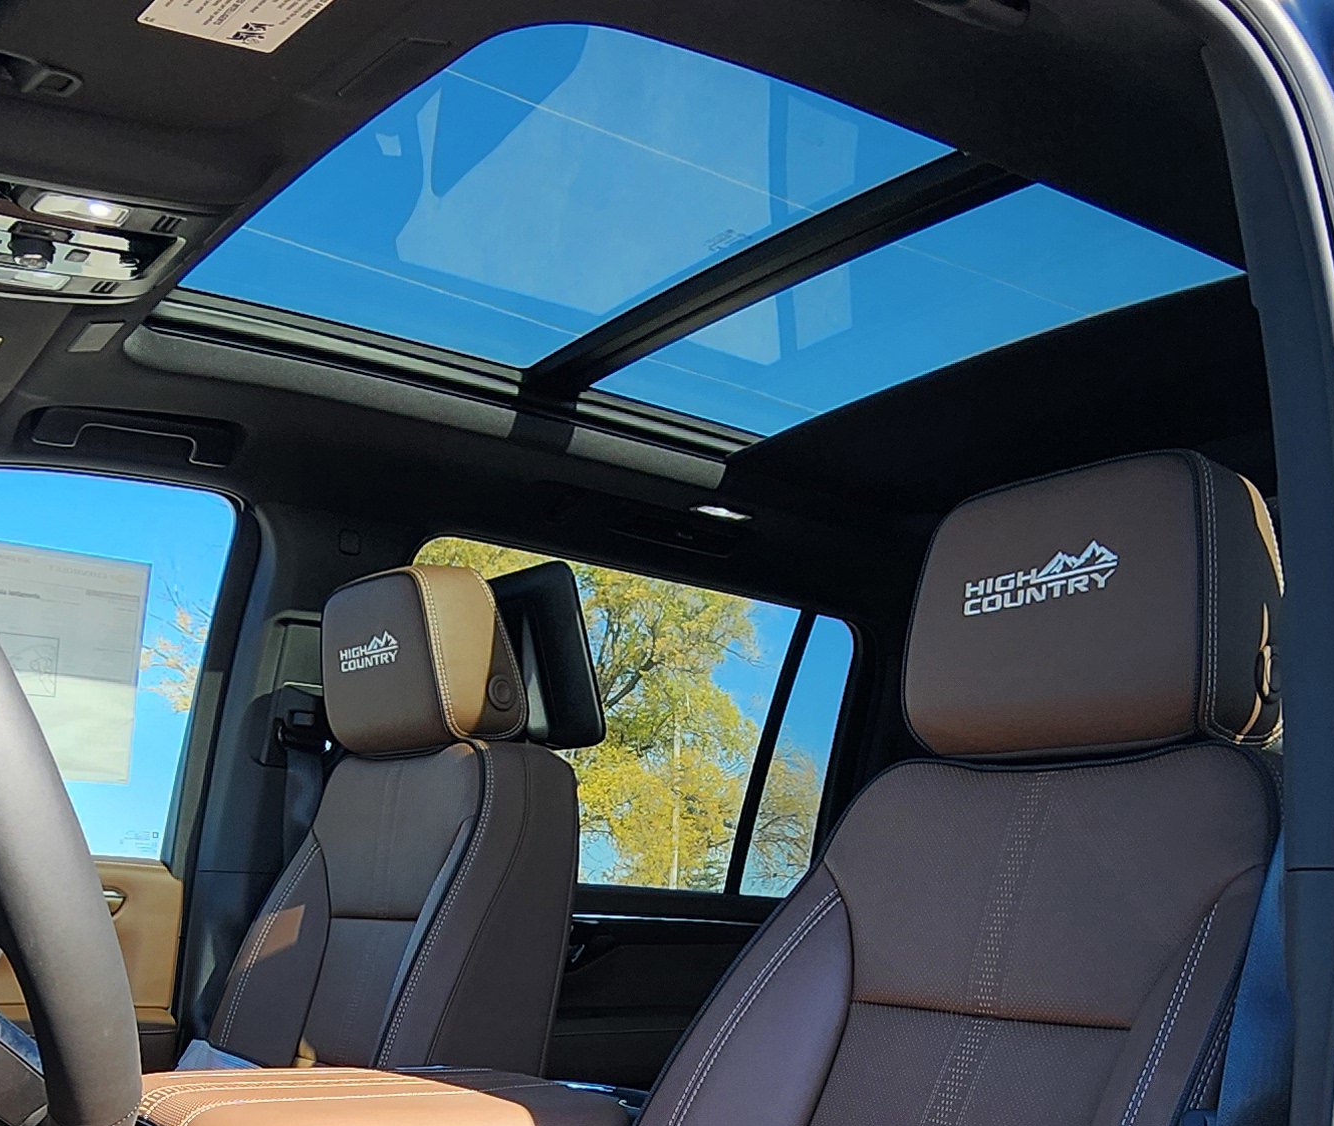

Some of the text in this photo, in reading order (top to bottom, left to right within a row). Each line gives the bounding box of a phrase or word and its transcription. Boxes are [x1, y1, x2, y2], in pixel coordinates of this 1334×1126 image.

[963, 570, 1116, 616] COUNTRY
[964, 568, 1037, 598] HIGH
[340, 645, 367, 660] HIGH
[341, 650, 398, 672] COUNTRY
